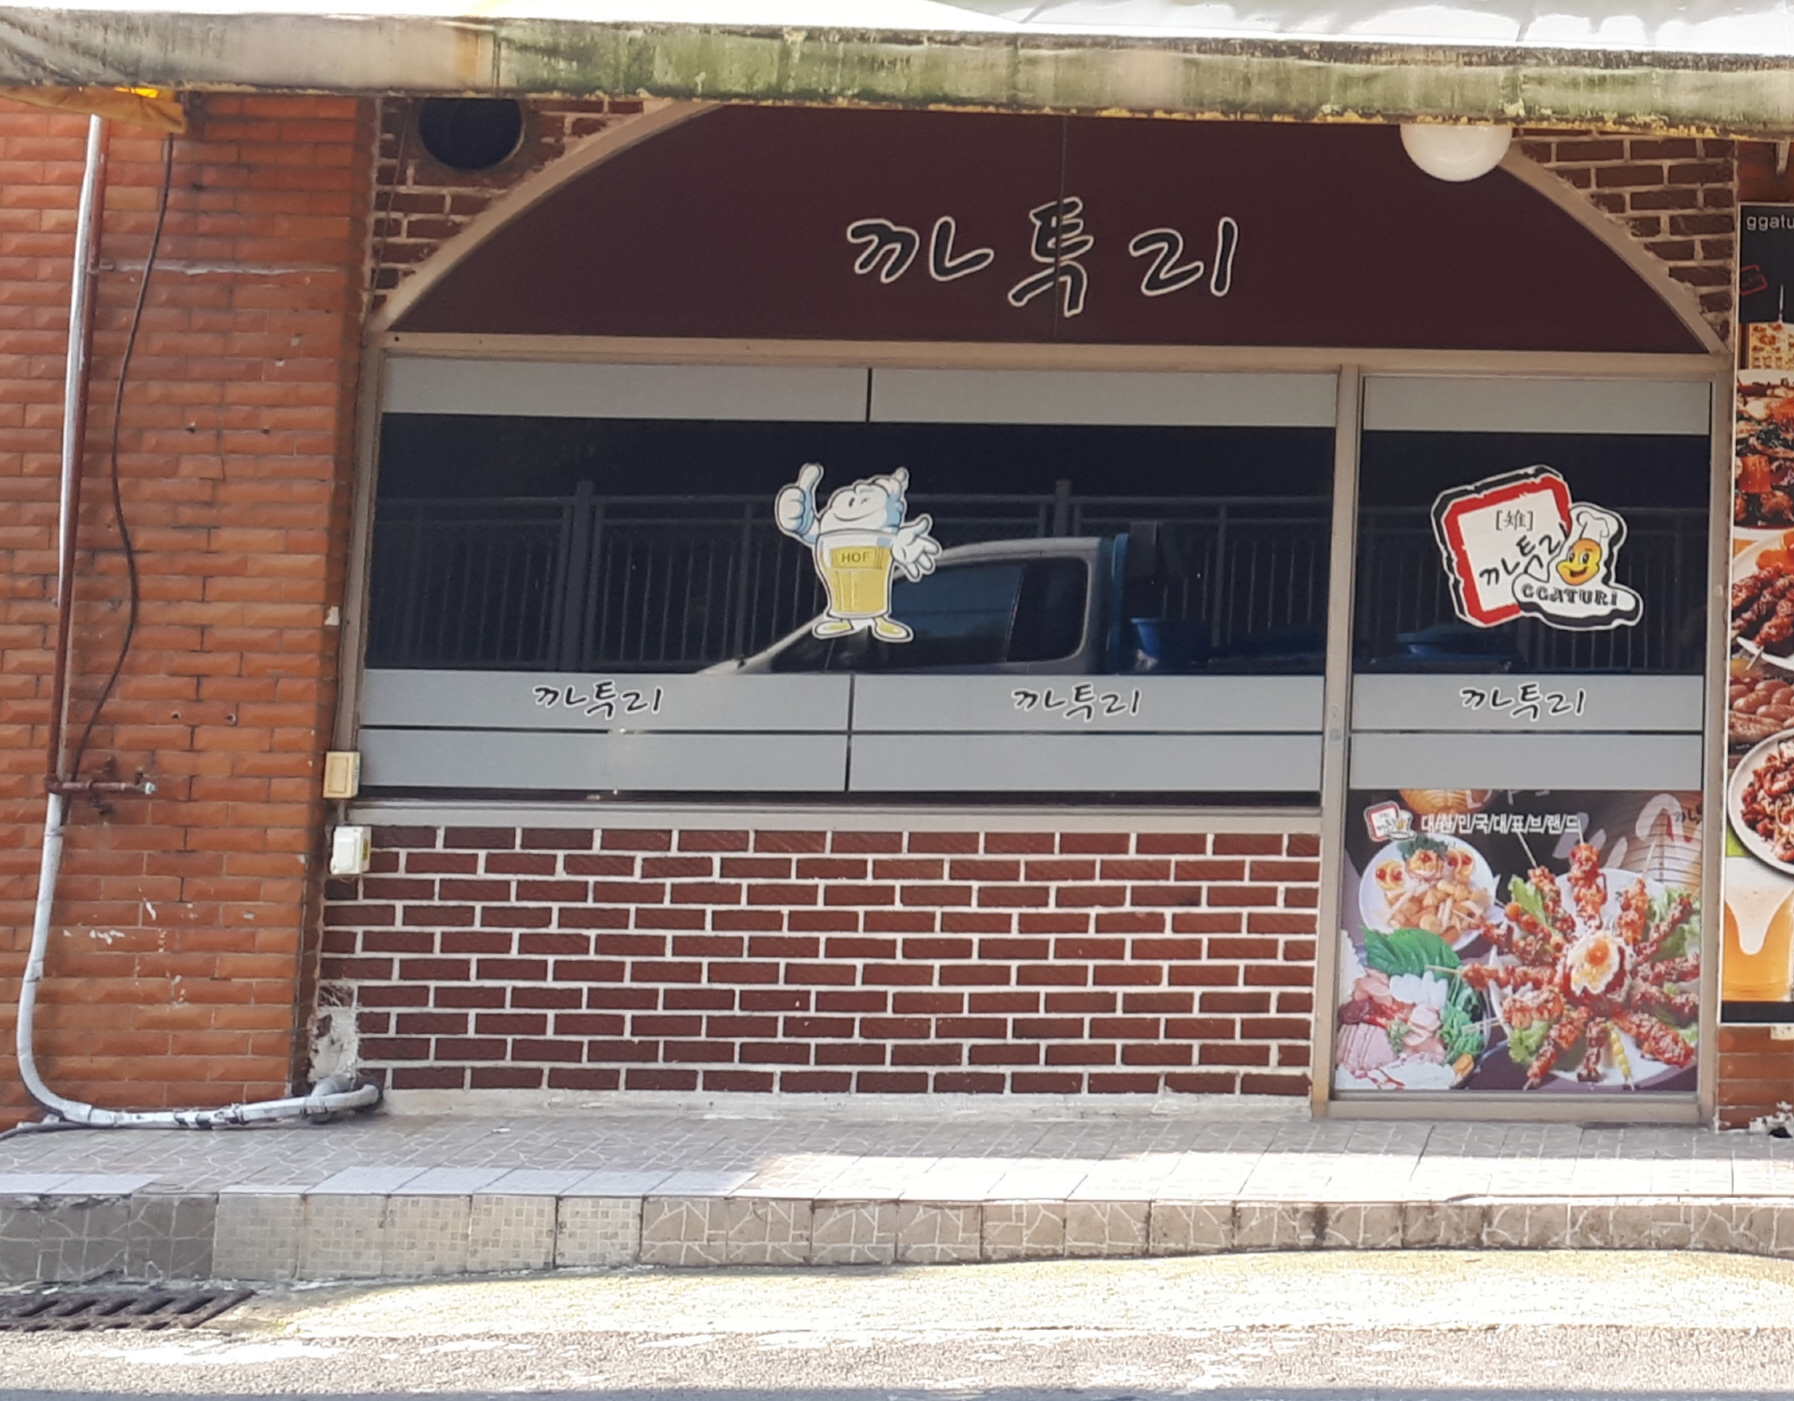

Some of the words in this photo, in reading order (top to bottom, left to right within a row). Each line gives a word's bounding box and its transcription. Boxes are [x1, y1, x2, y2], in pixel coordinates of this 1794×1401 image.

[847, 196, 1238, 318] 까투리
[841, 551, 870, 563] HOF
[534, 680, 664, 719] 까투리
[1012, 682, 1141, 721] 까투리
[1460, 682, 1586, 722] 까투리
